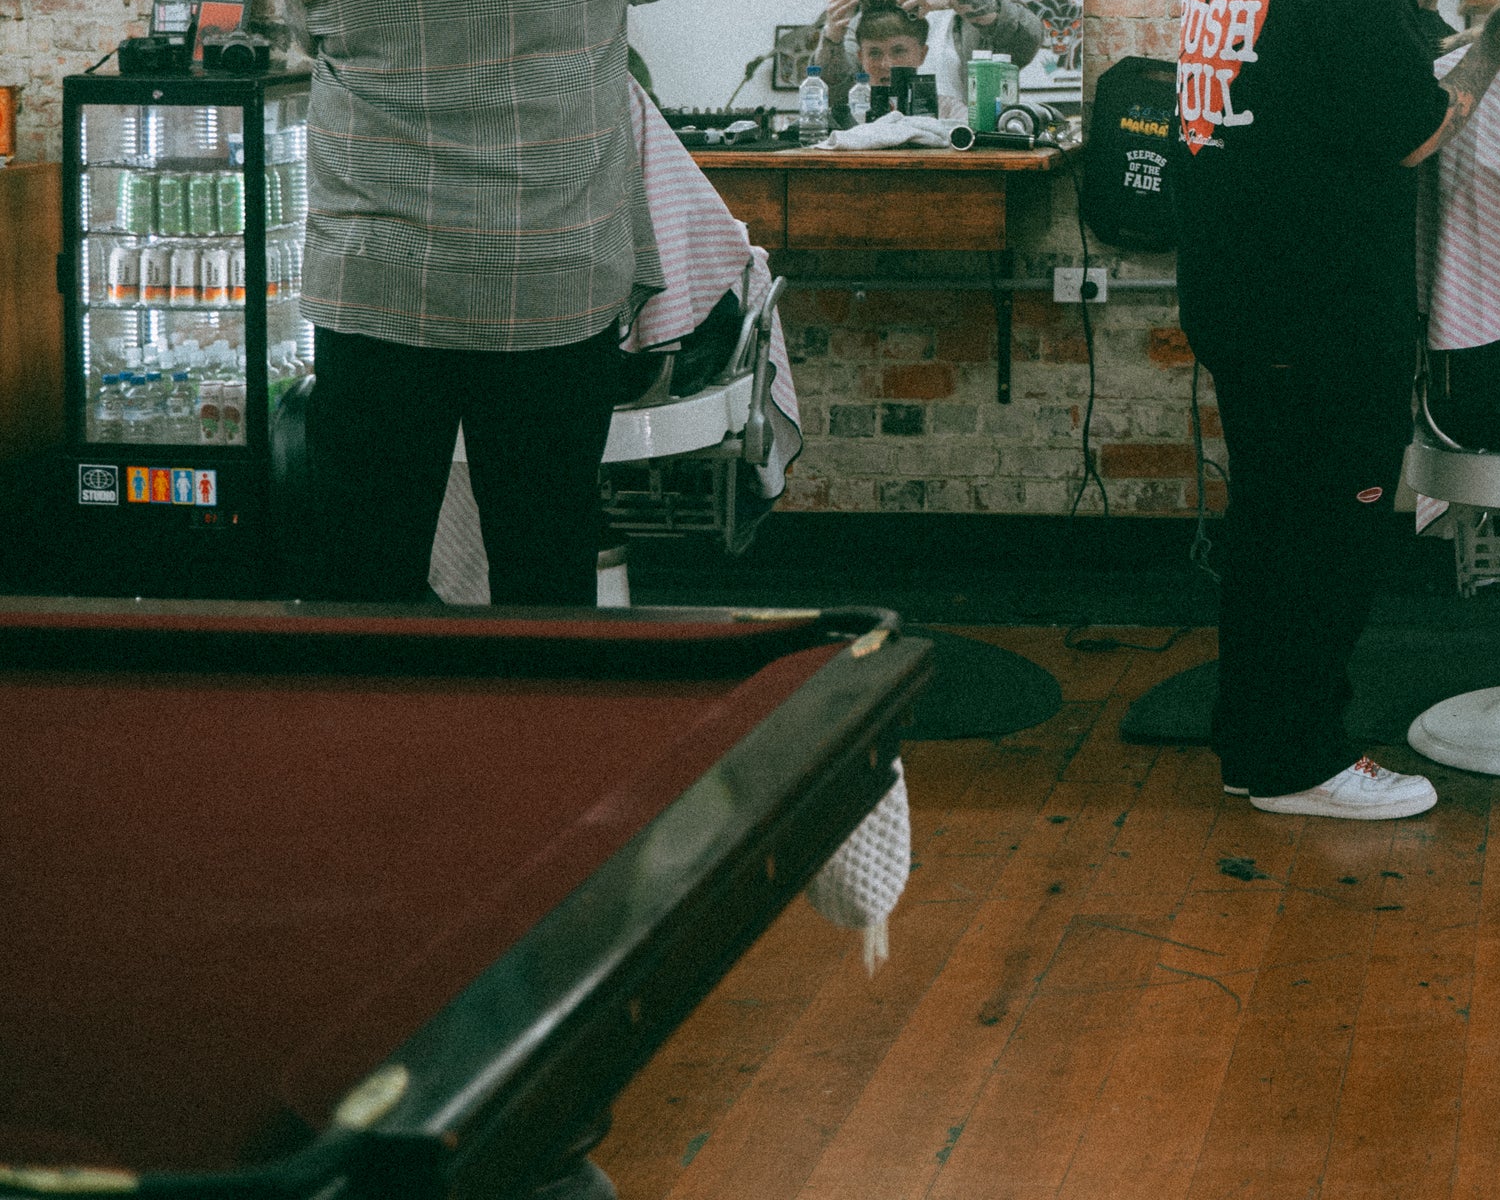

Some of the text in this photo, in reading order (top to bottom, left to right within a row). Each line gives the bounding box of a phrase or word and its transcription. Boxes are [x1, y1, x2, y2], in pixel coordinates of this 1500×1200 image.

[1175, 58, 1254, 128] ULL
[1126, 149, 1168, 167] KEEPERS
[1129, 161, 1161, 176] OF THE
[1123, 171, 1162, 192] FADE
[82, 489, 116, 502] STUDIO
